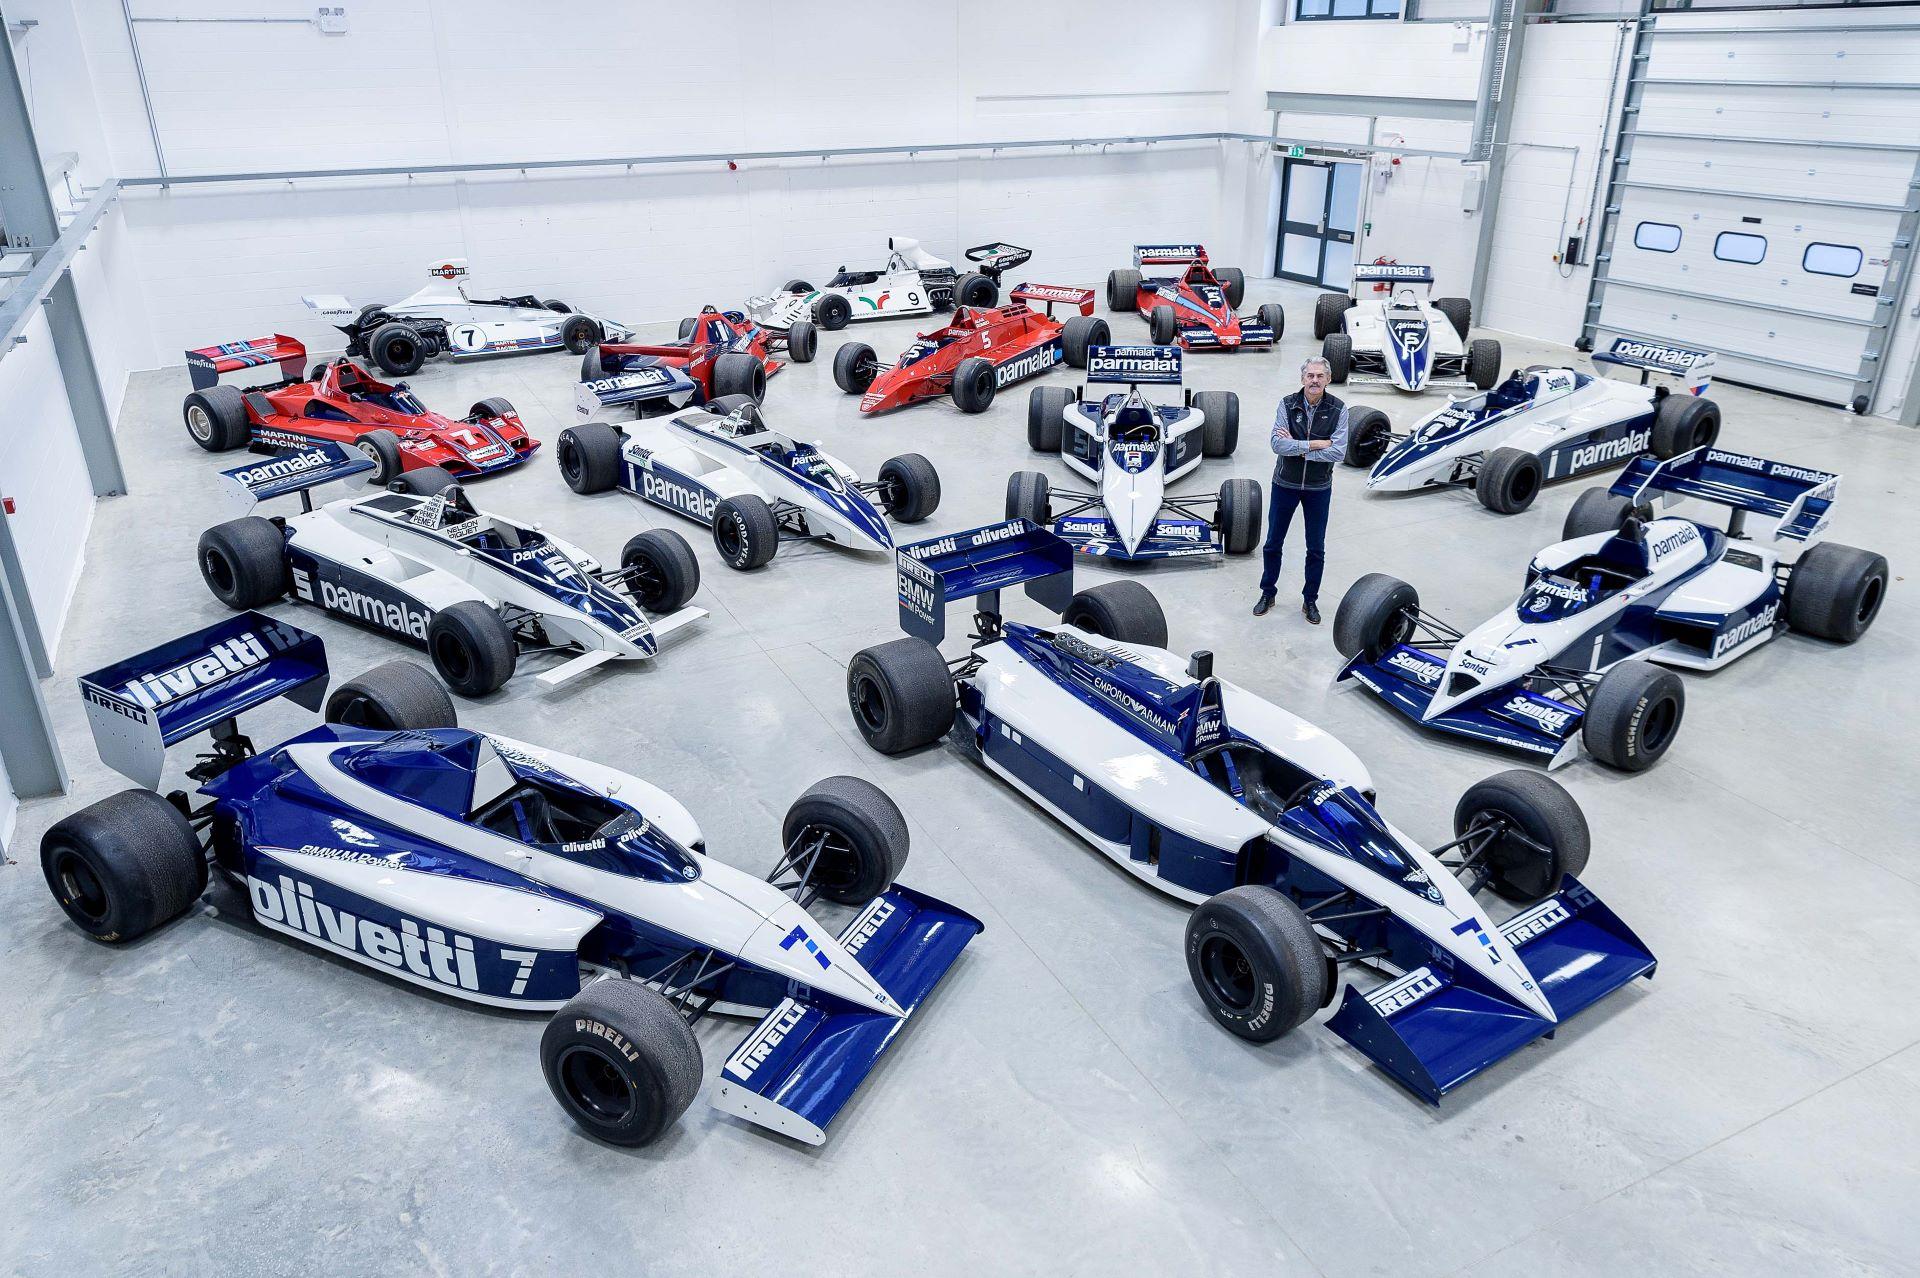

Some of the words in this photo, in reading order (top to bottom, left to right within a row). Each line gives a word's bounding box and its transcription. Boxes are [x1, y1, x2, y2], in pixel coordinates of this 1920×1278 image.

[999, 252, 1030, 263] GOODYEAR
[1139, 246, 1197, 262] parmalat
[432, 267, 465, 277] MARTINI
[1356, 265, 1425, 277] parmalat
[907, 292, 920, 306] 9
[461, 330, 475, 347] 7
[980, 331, 992, 350] 5
[1097, 348, 1107, 358] 5
[1114, 347, 1155, 358] parmalat
[1163, 348, 1173, 358] 5
[1615, 340, 1705, 367] parmalat
[186, 358, 216, 370] GOODYEAR
[996, 344, 1056, 387] parmalat
[1090, 357, 1179, 372] parmalat
[583, 368, 668, 393] parmalat
[260, 429, 307, 443] MARTINI
[262, 438, 309, 450] RACING
[449, 429, 479, 446] 7
[1112, 442, 1157, 453] parmalat
[1569, 428, 1652, 474] parmalat
[235, 449, 332, 487] parmalat
[791, 453, 825, 468] parma
[1670, 452, 1697, 471] parmalat
[1706, 450, 1766, 471] parmalat
[1770, 463, 1834, 485] parmalat
[413, 515, 437, 529] PEMEX
[419, 508, 438, 519] PEMEX
[446, 519, 479, 535] NELSON
[971, 520, 1025, 546] olivetti
[731, 511, 750, 568] GOODYEAR
[1651, 526, 1698, 562] parmalat
[512, 543, 558, 565] parma
[1167, 548, 1218, 558] MICHELIN
[898, 553, 935, 586] PIRELLI
[897, 572, 935, 613] BMW
[1528, 580, 1588, 603] parmalat
[292, 567, 314, 602] 5
[319, 579, 431, 641] parmalat
[914, 603, 936, 626] Power
[1351, 669, 1383, 694] MICHELIN
[82, 682, 149, 726] PIRELLI
[1093, 676, 1132, 707] EMPORIO
[1140, 708, 1177, 736] ARMANI
[1195, 719, 1221, 738] BMW
[1199, 731, 1221, 744] Power
[1627, 696, 1648, 758] MICHELIN
[1496, 736, 1556, 755] MICHELIN
[1313, 787, 1338, 806] oliv
[619, 817, 650, 844] olive
[562, 838, 606, 853] olivetti
[247, 874, 480, 992] olivetti
[500, 948, 539, 996] 7
[1450, 917, 1502, 965] 7
[778, 924, 832, 971] 7
[1247, 982, 1274, 1031] PIRELLI
[575, 1018, 640, 1063] PIRELLI
[724, 997, 808, 1082] PIRELLI
